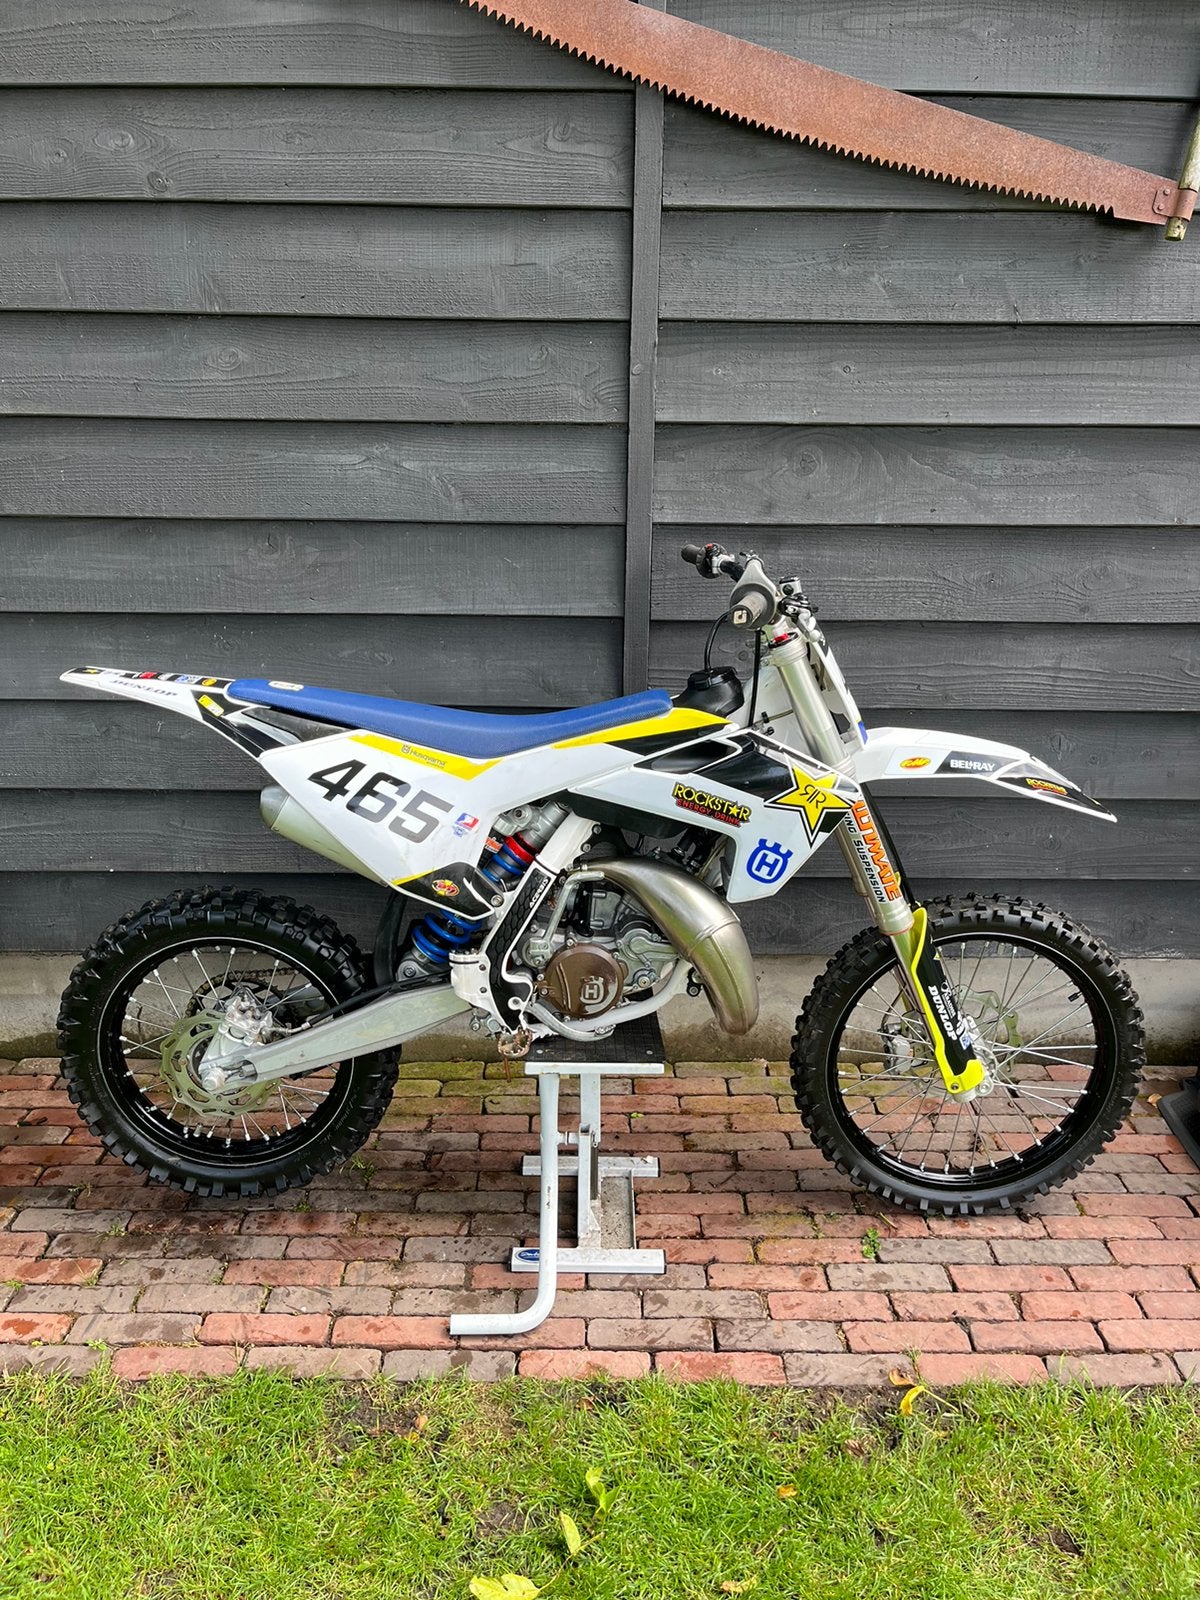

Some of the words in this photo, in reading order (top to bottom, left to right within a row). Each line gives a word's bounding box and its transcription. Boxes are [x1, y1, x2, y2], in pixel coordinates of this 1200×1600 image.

[410, 749, 446, 766] Husqvarna
[307, 759, 454, 844] 465
[676, 798, 712, 815] ENERGY
[714, 811, 741, 827] DRINK
[851, 799, 902, 902] ULTIMATE
[854, 839, 886, 903] SUSPENSION
[928, 985, 957, 1041] DUNLOP
